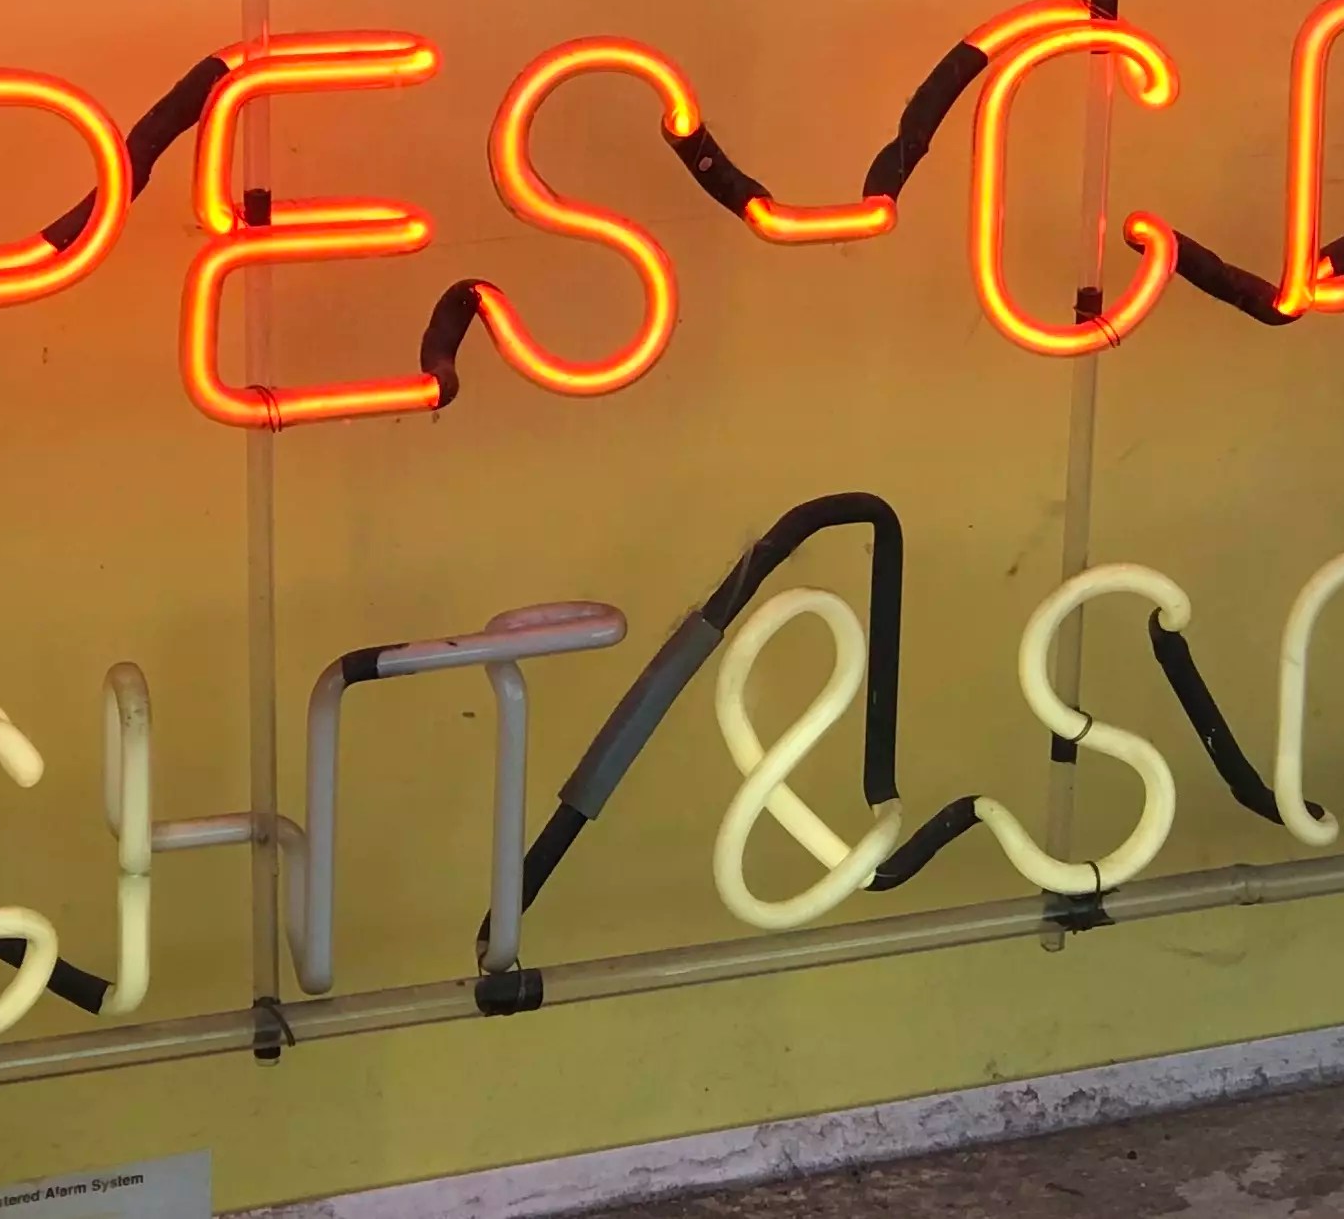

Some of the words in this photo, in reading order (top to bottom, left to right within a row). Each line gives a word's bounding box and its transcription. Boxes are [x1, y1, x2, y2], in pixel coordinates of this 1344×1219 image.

[713, 586, 903, 930] &
[44, 1183, 87, 1200] Alarm
[91, 1172, 144, 1194] System
